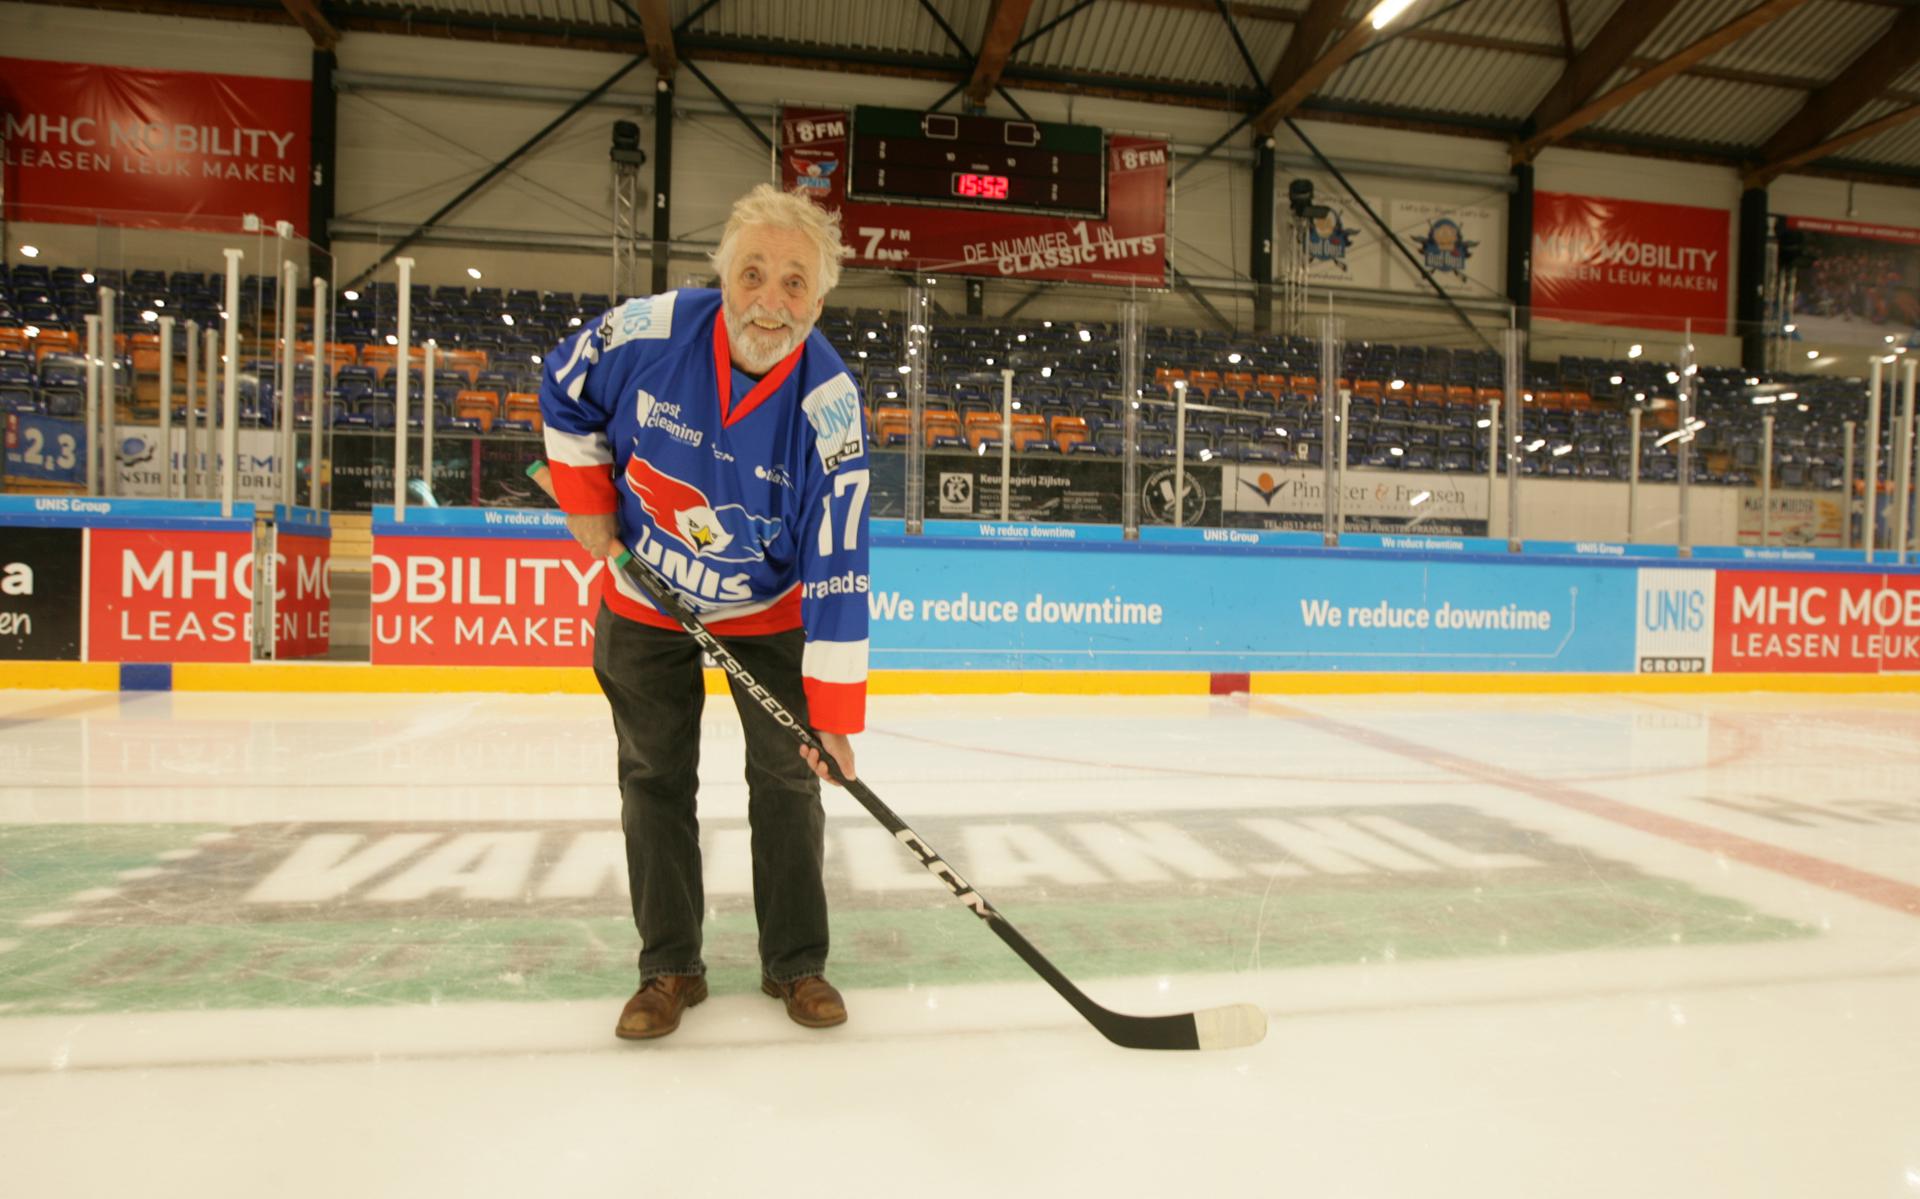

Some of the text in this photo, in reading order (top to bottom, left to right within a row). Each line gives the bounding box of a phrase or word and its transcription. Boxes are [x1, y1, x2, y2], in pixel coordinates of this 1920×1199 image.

[5, 113, 295, 159] MHC MOBILITY
[5, 148, 295, 184] LEASEN LEUK MAKEN
[958, 173, 1009, 199] 15:52
[890, 228, 911, 241] FM
[963, 221, 1115, 264] DE NUMMER 1 IN
[997, 236, 1157, 275] CLASSIC HITS
[1599, 241, 1718, 273] MOBILITY
[1608, 268, 1651, 286] LEUK
[1658, 273, 1718, 292] MAKEN
[652, 401, 682, 420] post
[646, 414, 704, 448] cleaning
[35, 498, 111, 513] UNIS Group
[485, 511, 503, 524] We
[505, 511, 540, 525] reduce
[818, 468, 870, 557] 17
[980, 524, 1076, 539] We reduce downtime
[1203, 530, 1260, 544] UNIS Group
[1382, 536, 1464, 551] We reduce downtime
[635, 523, 753, 601] UNIS
[868, 591, 1163, 625] We reduce downtime
[1300, 599, 1550, 631] We reduce downtime
[1644, 589, 1705, 633] UNIS
[1732, 585, 1827, 626] MHC
[1731, 633, 1920, 659] LEASEN LEUK
[682, 621, 794, 727] JETSPEED
[1642, 658, 1704, 673] GROUP
